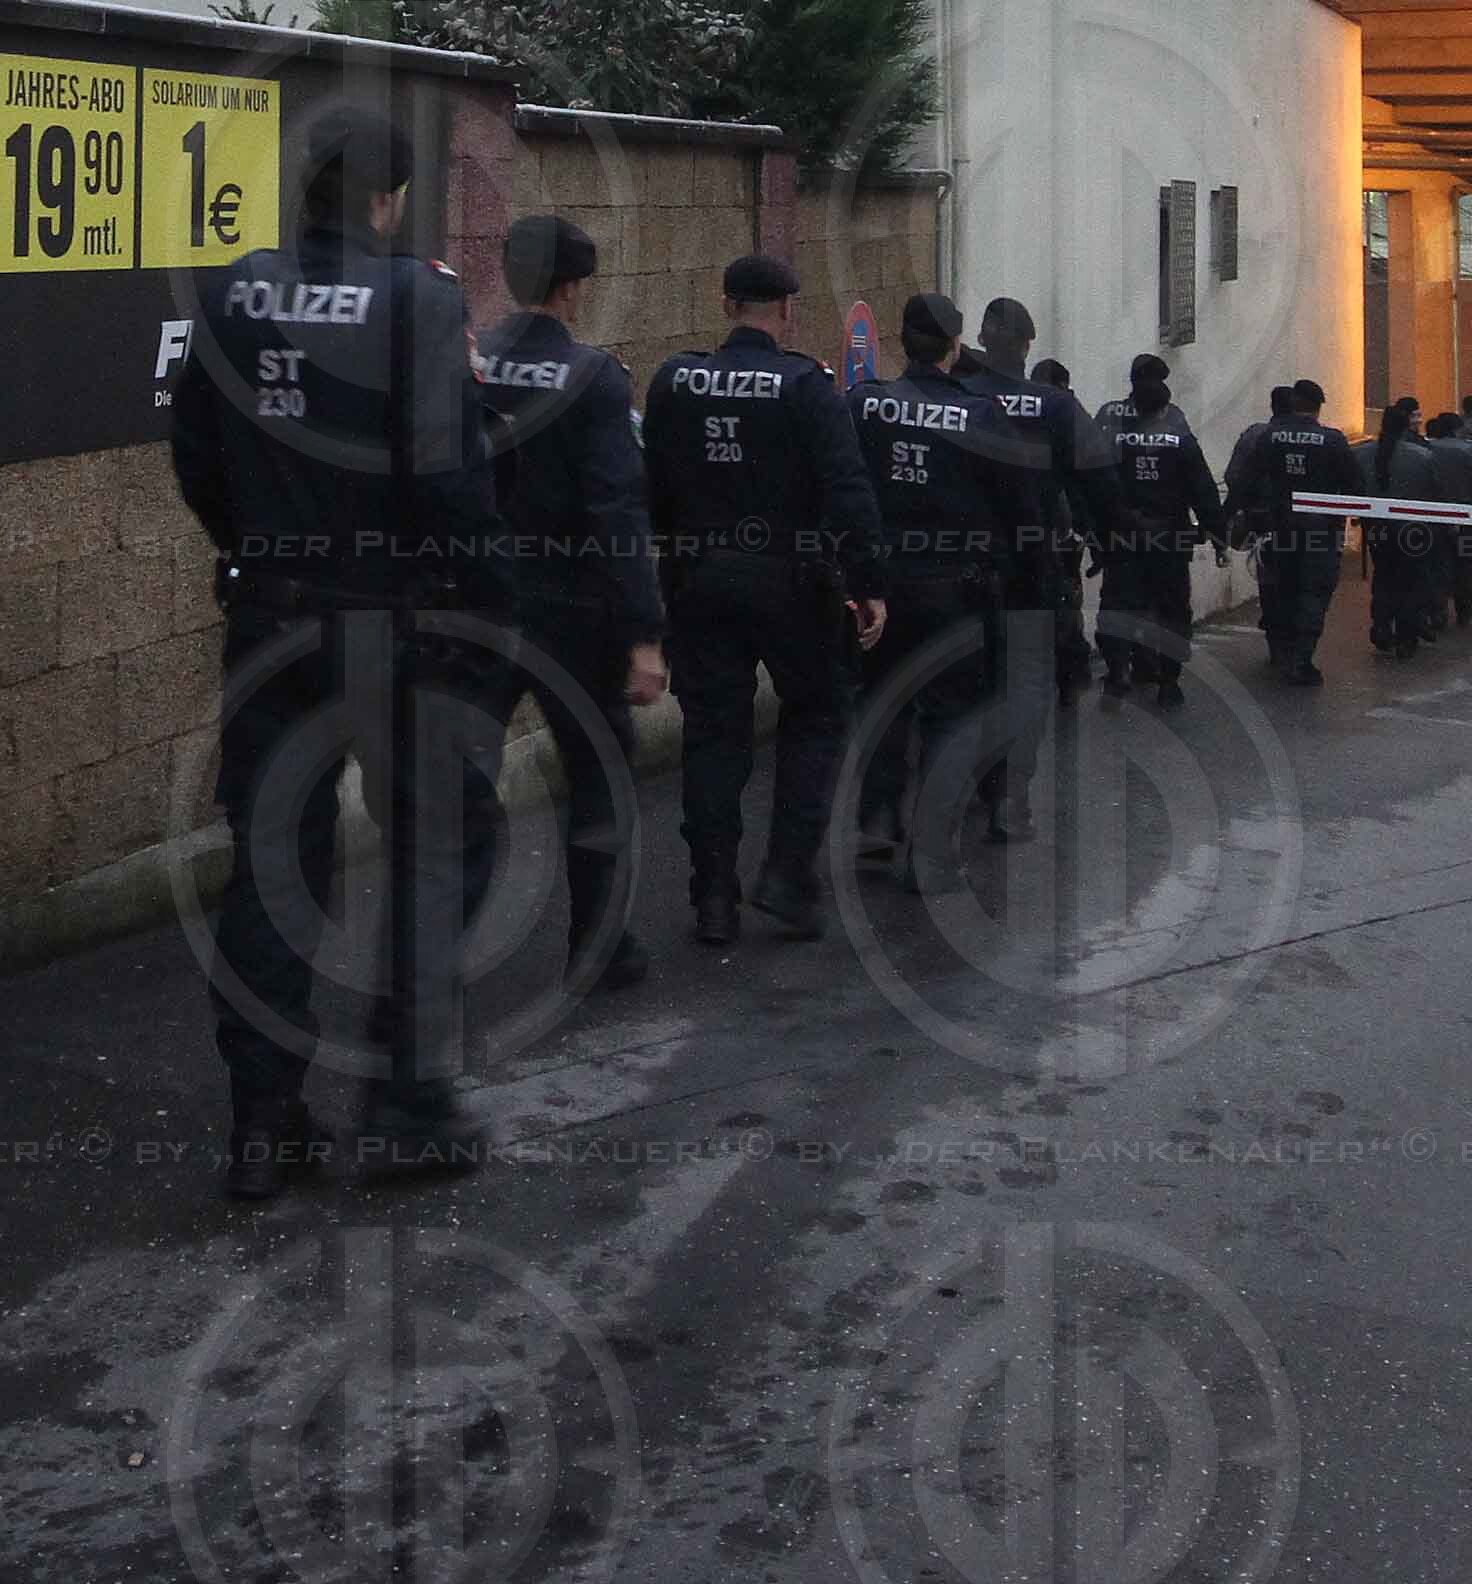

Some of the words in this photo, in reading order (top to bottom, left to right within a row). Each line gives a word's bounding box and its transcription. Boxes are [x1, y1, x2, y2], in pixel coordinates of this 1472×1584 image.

[4, 69, 125, 114] JAHRES-ABO
[151, 78, 218, 110] SOLARIUM
[221, 85, 242, 111] UM
[244, 87, 270, 113] NUR
[83, 217, 123, 256] mtl.
[226, 280, 374, 325] POLIZEI
[258, 349, 306, 382] ST
[672, 367, 782, 400] POLIZEI
[154, 390, 173, 407] Die
[705, 416, 740, 439] ST
[862, 396, 968, 433] POLIZEI
[1115, 432, 1180, 448] POLIZEI
[1271, 431, 1325, 446] POLIZEI
[705, 441, 743, 463] 220
[892, 440, 929, 466] ST
[1135, 456, 1159, 469] ST
[890, 464, 928, 485] 230
